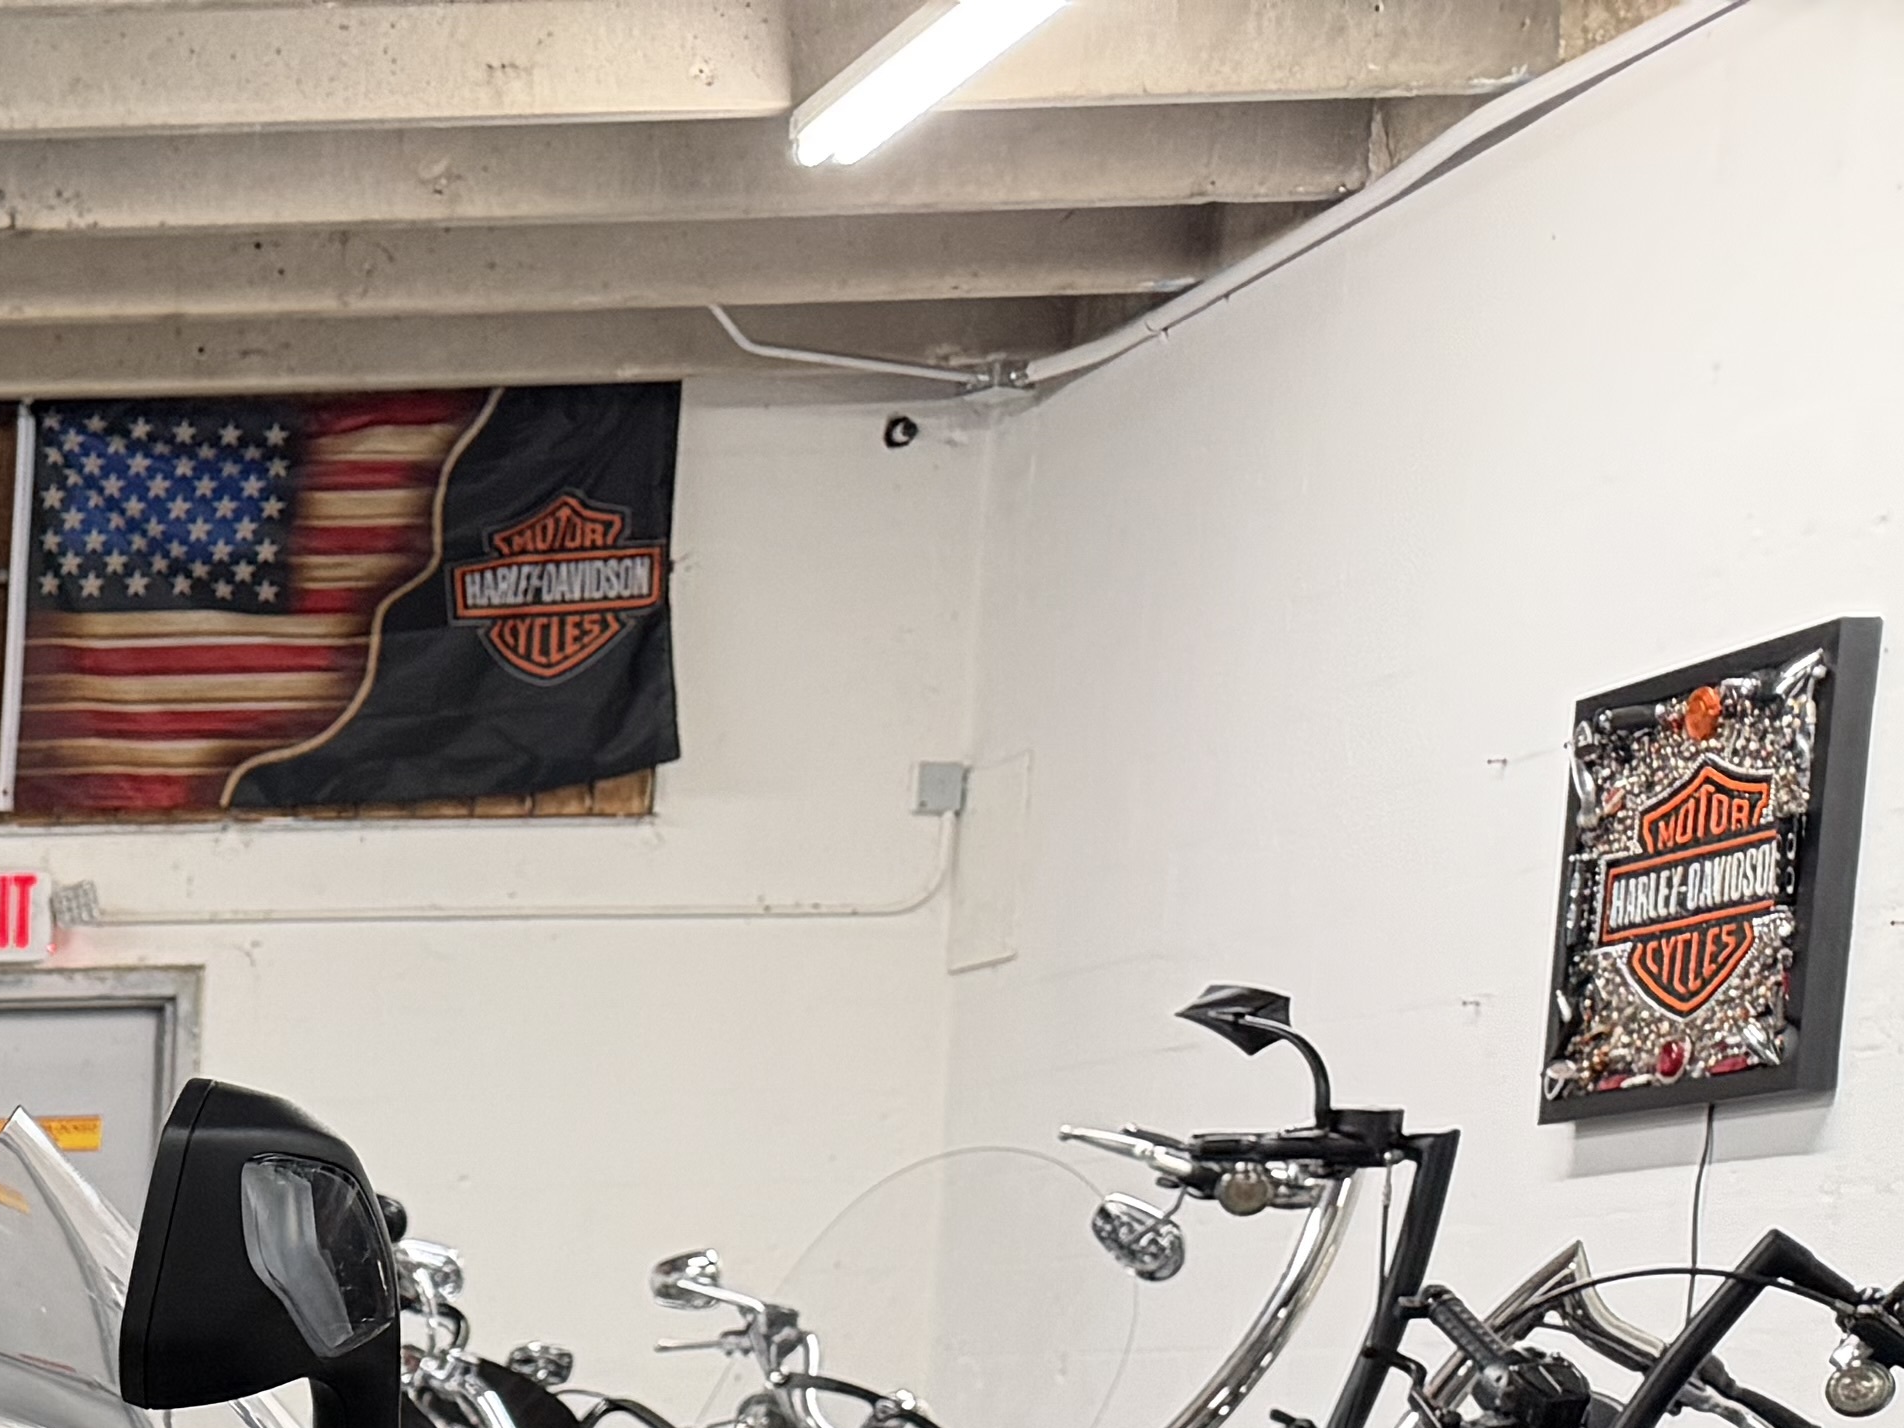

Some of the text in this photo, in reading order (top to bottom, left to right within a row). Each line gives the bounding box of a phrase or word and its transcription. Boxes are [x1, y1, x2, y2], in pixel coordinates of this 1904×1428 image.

[511, 506, 606, 552] MOTOR
[463, 555, 651, 608] HARLEY-DAVIDSON
[502, 614, 604, 666] CYCLES
[1657, 784, 1751, 853] MOTOR
[1646, 924, 1738, 996] CYCLES
